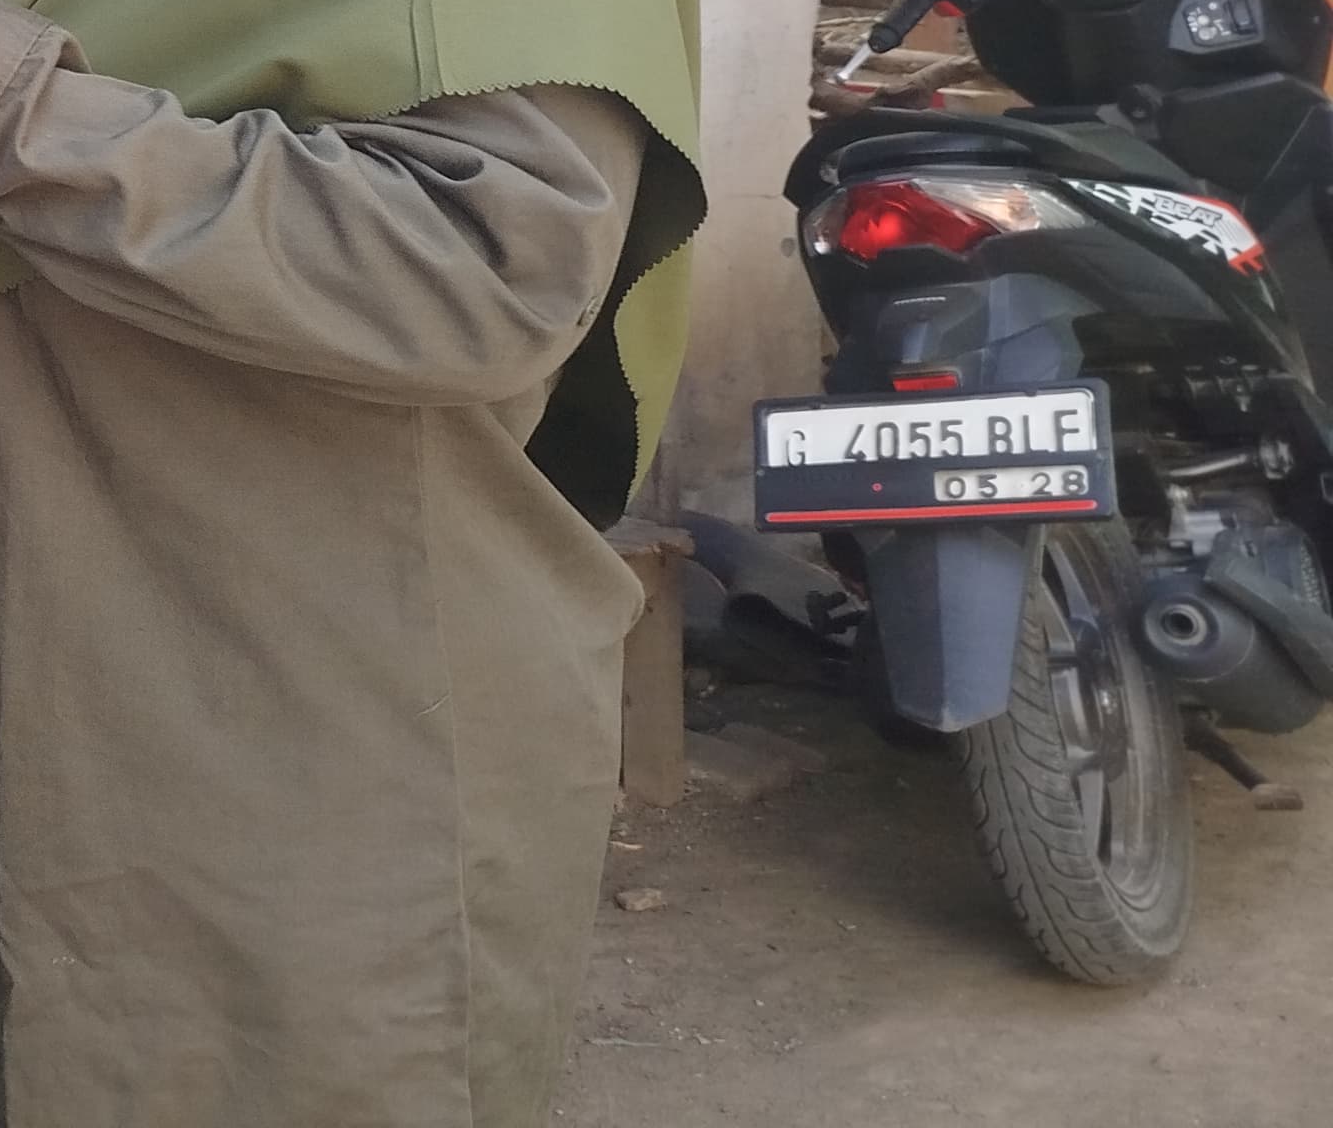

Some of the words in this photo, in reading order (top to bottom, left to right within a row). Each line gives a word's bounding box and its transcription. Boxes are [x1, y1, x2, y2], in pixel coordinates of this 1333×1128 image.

[1155, 193, 1223, 227] BEAT
[787, 430, 807, 467] G
[843, 420, 964, 462] 4055
[944, 474, 999, 499] 05
[1030, 470, 1087, 496] 28
